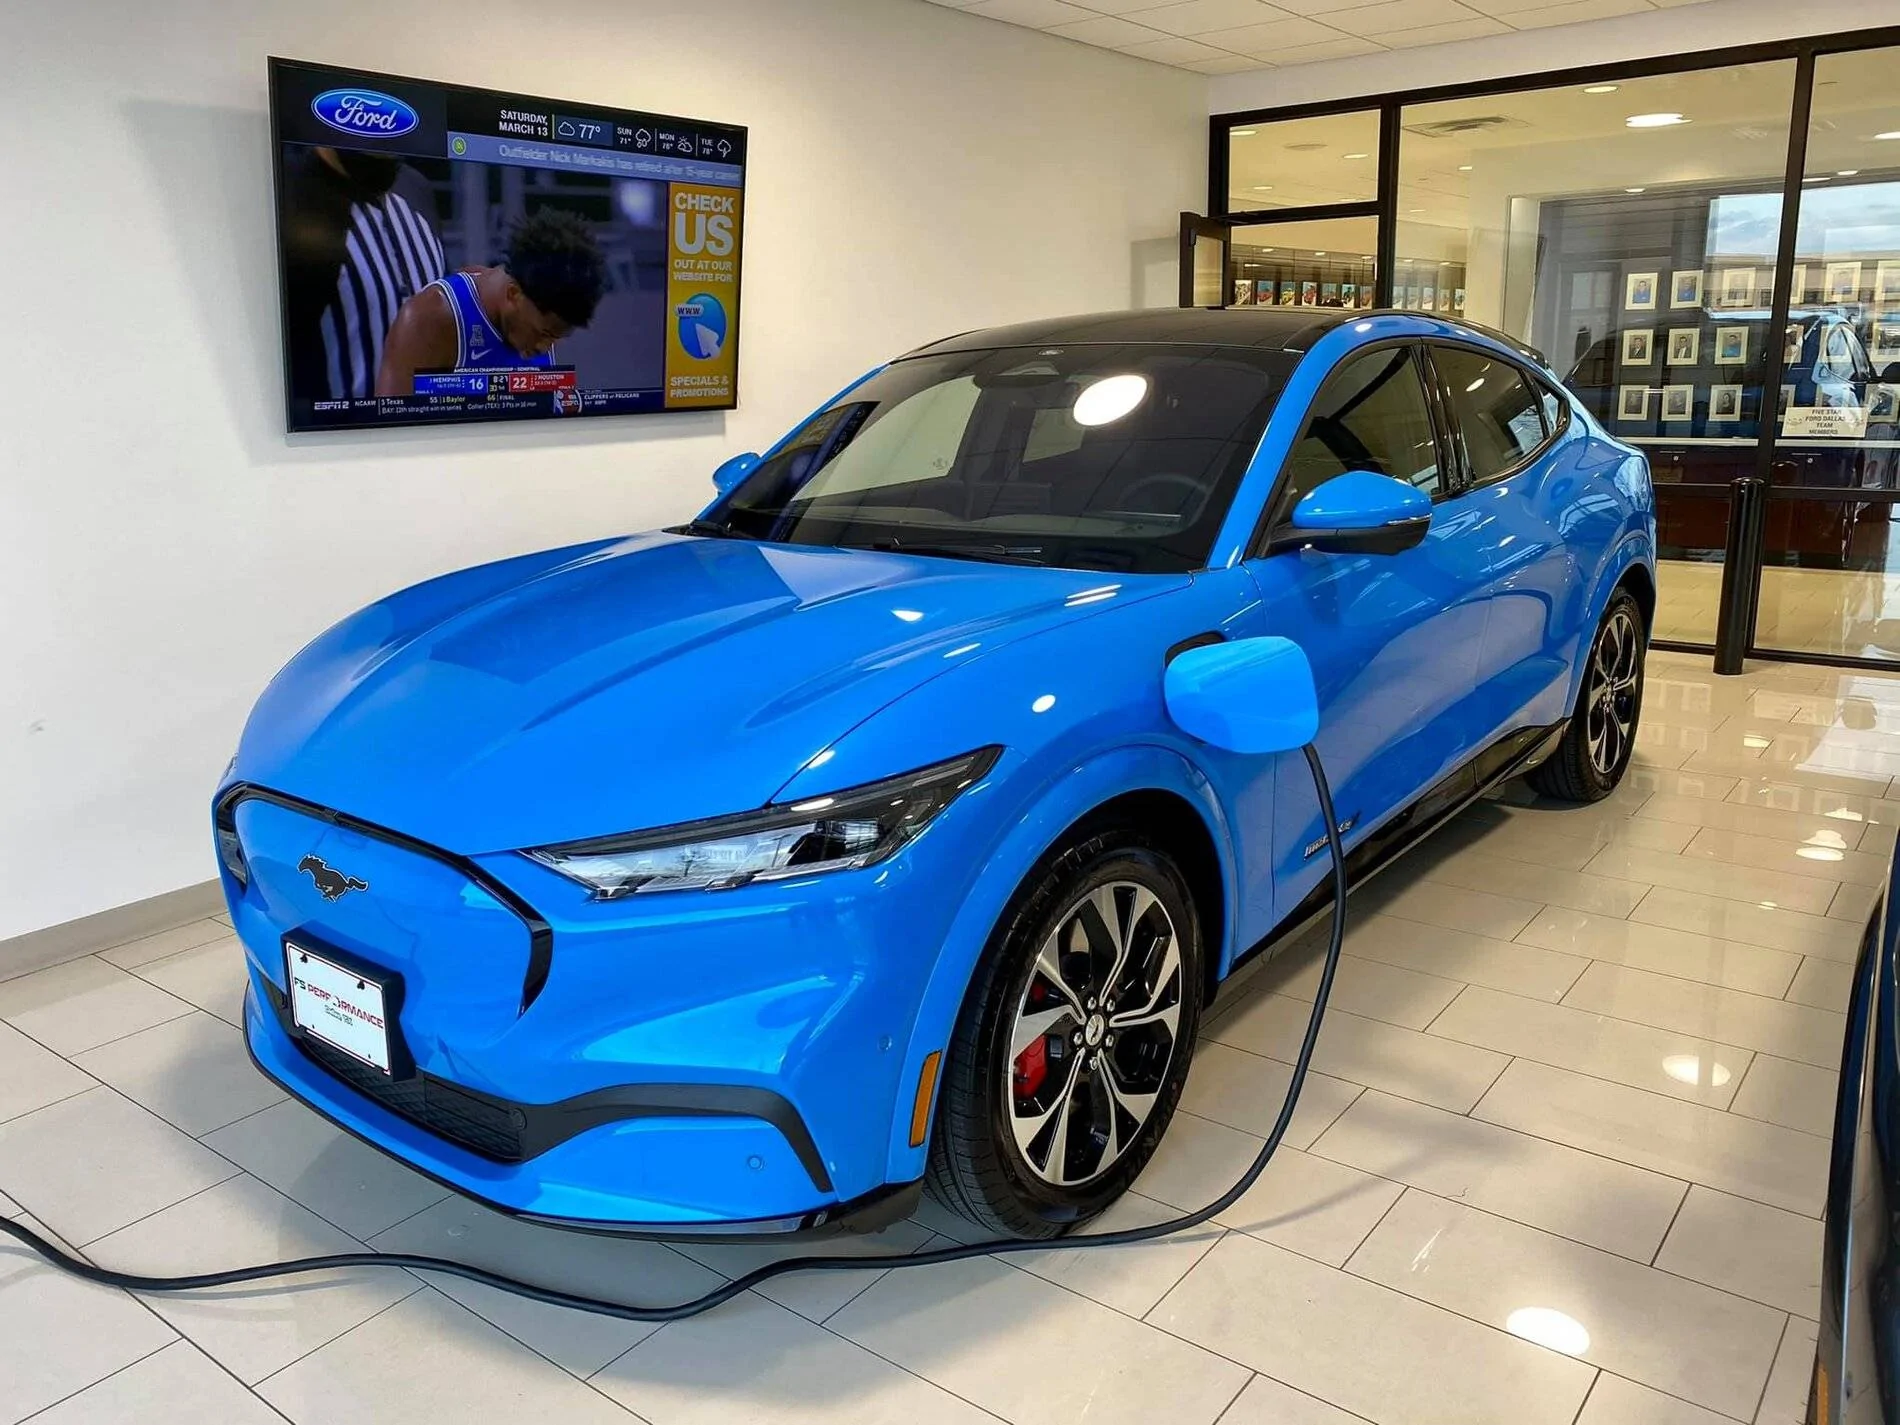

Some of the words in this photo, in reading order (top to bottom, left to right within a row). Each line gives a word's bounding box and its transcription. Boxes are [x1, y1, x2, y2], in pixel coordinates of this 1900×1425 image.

[335, 96, 397, 130] Ford
[500, 109, 548, 126] SATURDAY,
[499, 121, 534, 135] MARCH
[537, 127, 548, 137] 13
[578, 123, 601, 140] 77°
[616, 127, 632, 136] SUN
[659, 133, 675, 141] MON
[701, 138, 714, 146] TUE
[550, 150, 571, 163] Nick
[616, 159, 633, 170] has
[675, 192, 734, 213] CHECK
[675, 211, 734, 256] US
[674, 259, 695, 269] OUT
[697, 261, 710, 270] AT
[711, 261, 732, 271] OUR
[674, 271, 713, 281] WEBSITE
[714, 273, 733, 283] FOR
[469, 378, 484, 390] 16
[512, 377, 527, 389] 22
[670, 375, 720, 387] SPECIALS
[721, 375, 729, 385] &
[670, 387, 729, 398] PROMOTIONS
[445, 395, 465, 404] Baylor
